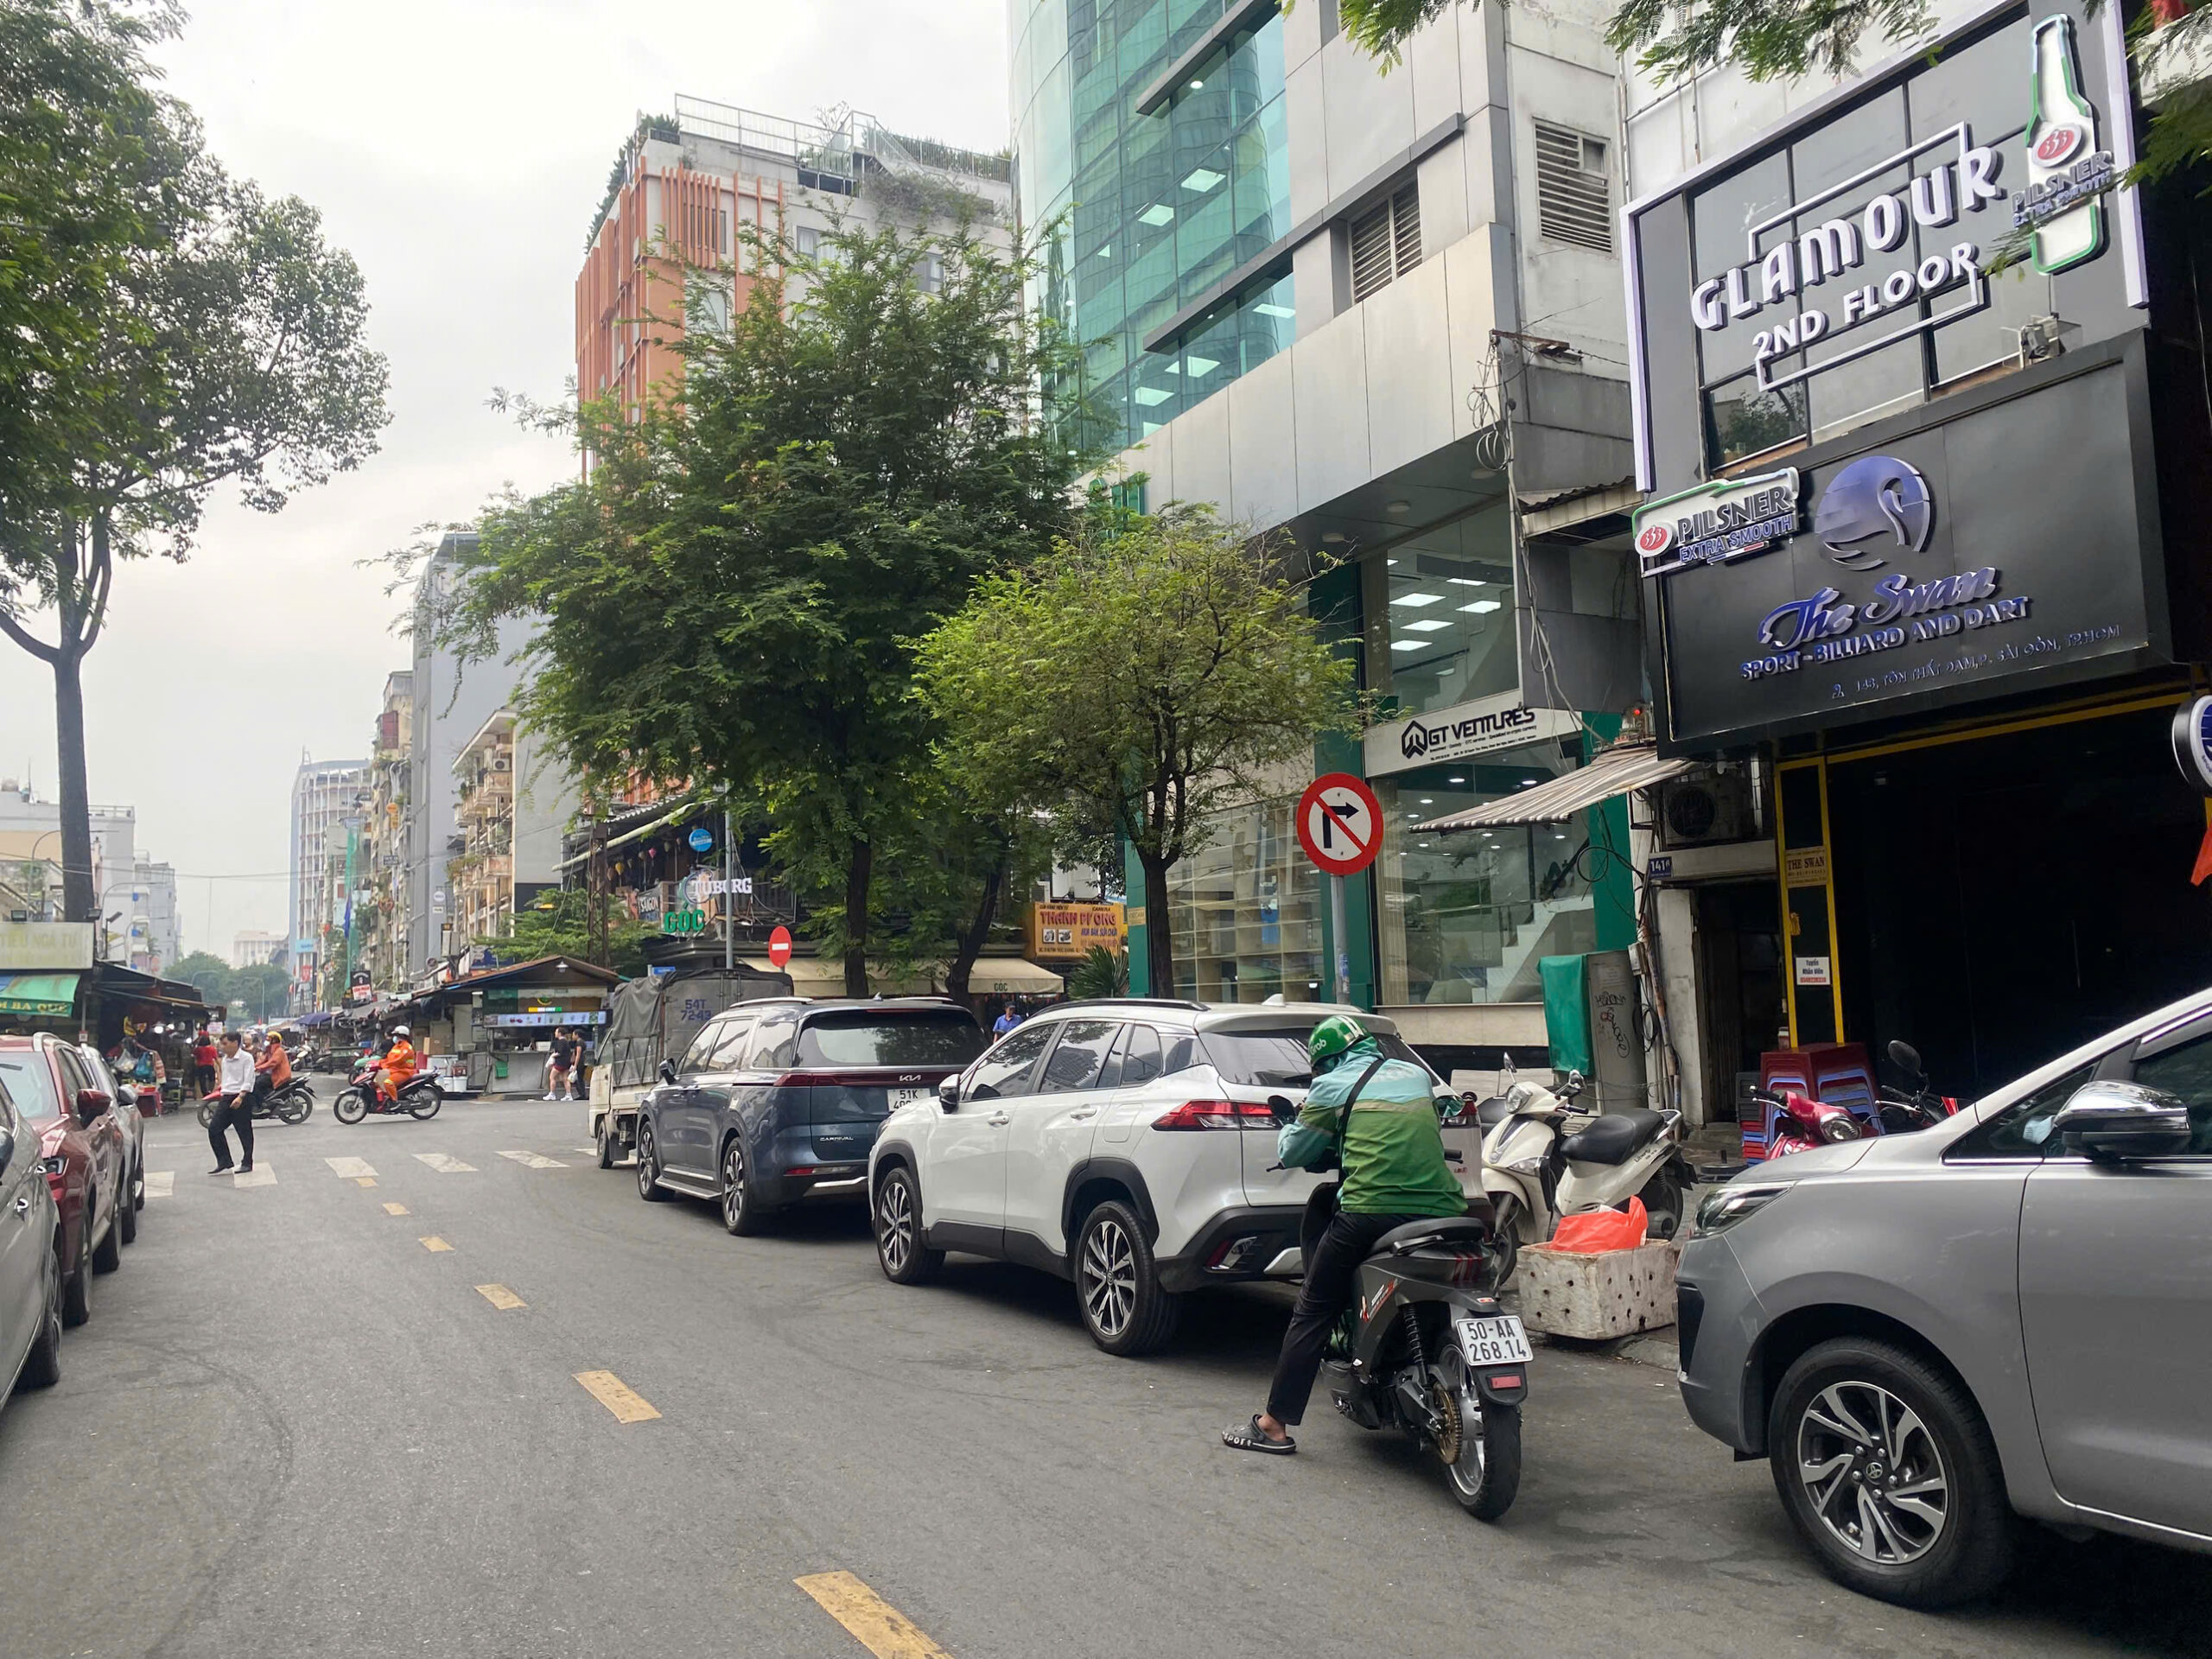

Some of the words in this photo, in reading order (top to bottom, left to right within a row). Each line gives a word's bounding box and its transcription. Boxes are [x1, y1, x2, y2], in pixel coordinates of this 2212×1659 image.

[2012, 150, 2113, 213] PILSNER
[1691, 145, 2003, 330] GLAMOUR
[1752, 309, 1830, 360] 2ND
[1843, 242, 1981, 324] FLOOR
[1677, 486, 1792, 544] PILSNER
[1679, 537, 1725, 563] EXTRA
[1730, 515, 1794, 548] SMOOTH
[1758, 587, 1855, 652] The
[1858, 567, 1998, 625] Swan
[1910, 614, 1961, 643] AND
[1963, 596, 2029, 630] DART
[1428, 725, 1450, 746] GT
[1451, 709, 1535, 740] VENTURES
[1787, 859, 1802, 870] THE
[1804, 856, 1825, 868] SWAN
[1039, 912, 1077, 925] THANH
[680, 1010, 712, 1020] 7243
[1310, 1039, 1327, 1056] Grab
[899, 1090, 918, 1099] 51K
[1467, 1319, 1516, 1340] 50-AA
[1469, 1338, 1527, 1363] 268.14
